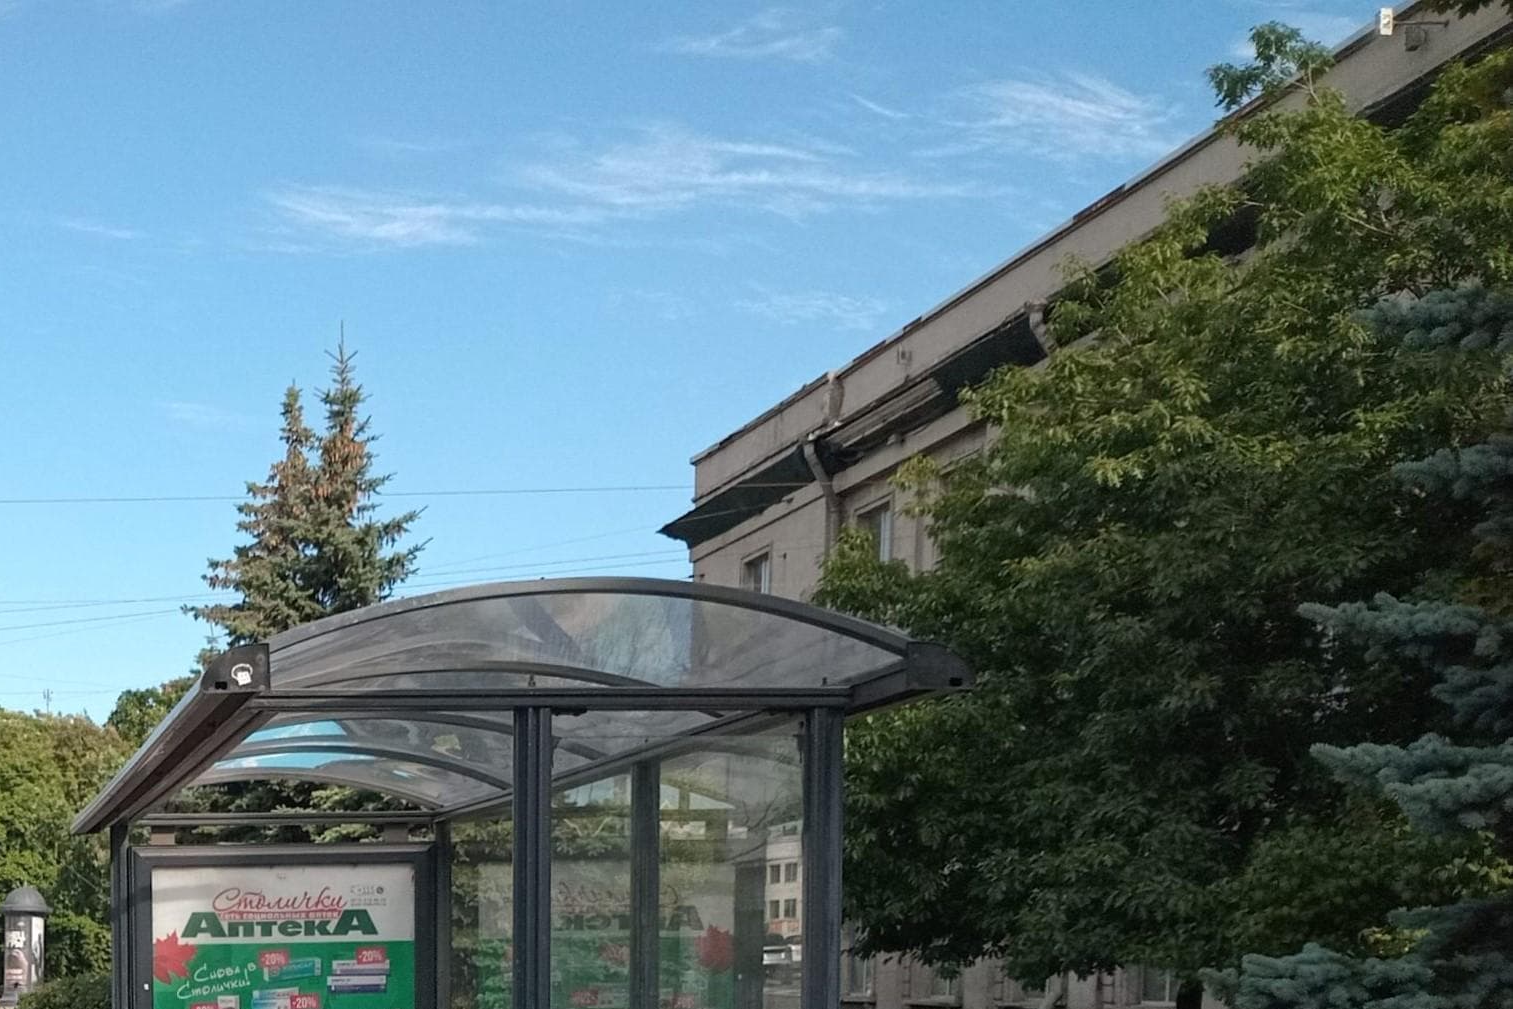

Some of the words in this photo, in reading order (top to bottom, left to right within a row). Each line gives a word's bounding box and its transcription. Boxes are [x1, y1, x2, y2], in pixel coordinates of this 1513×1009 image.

[213, 887, 348, 911] Столички
[261, 953, 286, 965] -20%
[358, 950, 383, 962] -20%
[292, 996, 317, 1009] -20%
